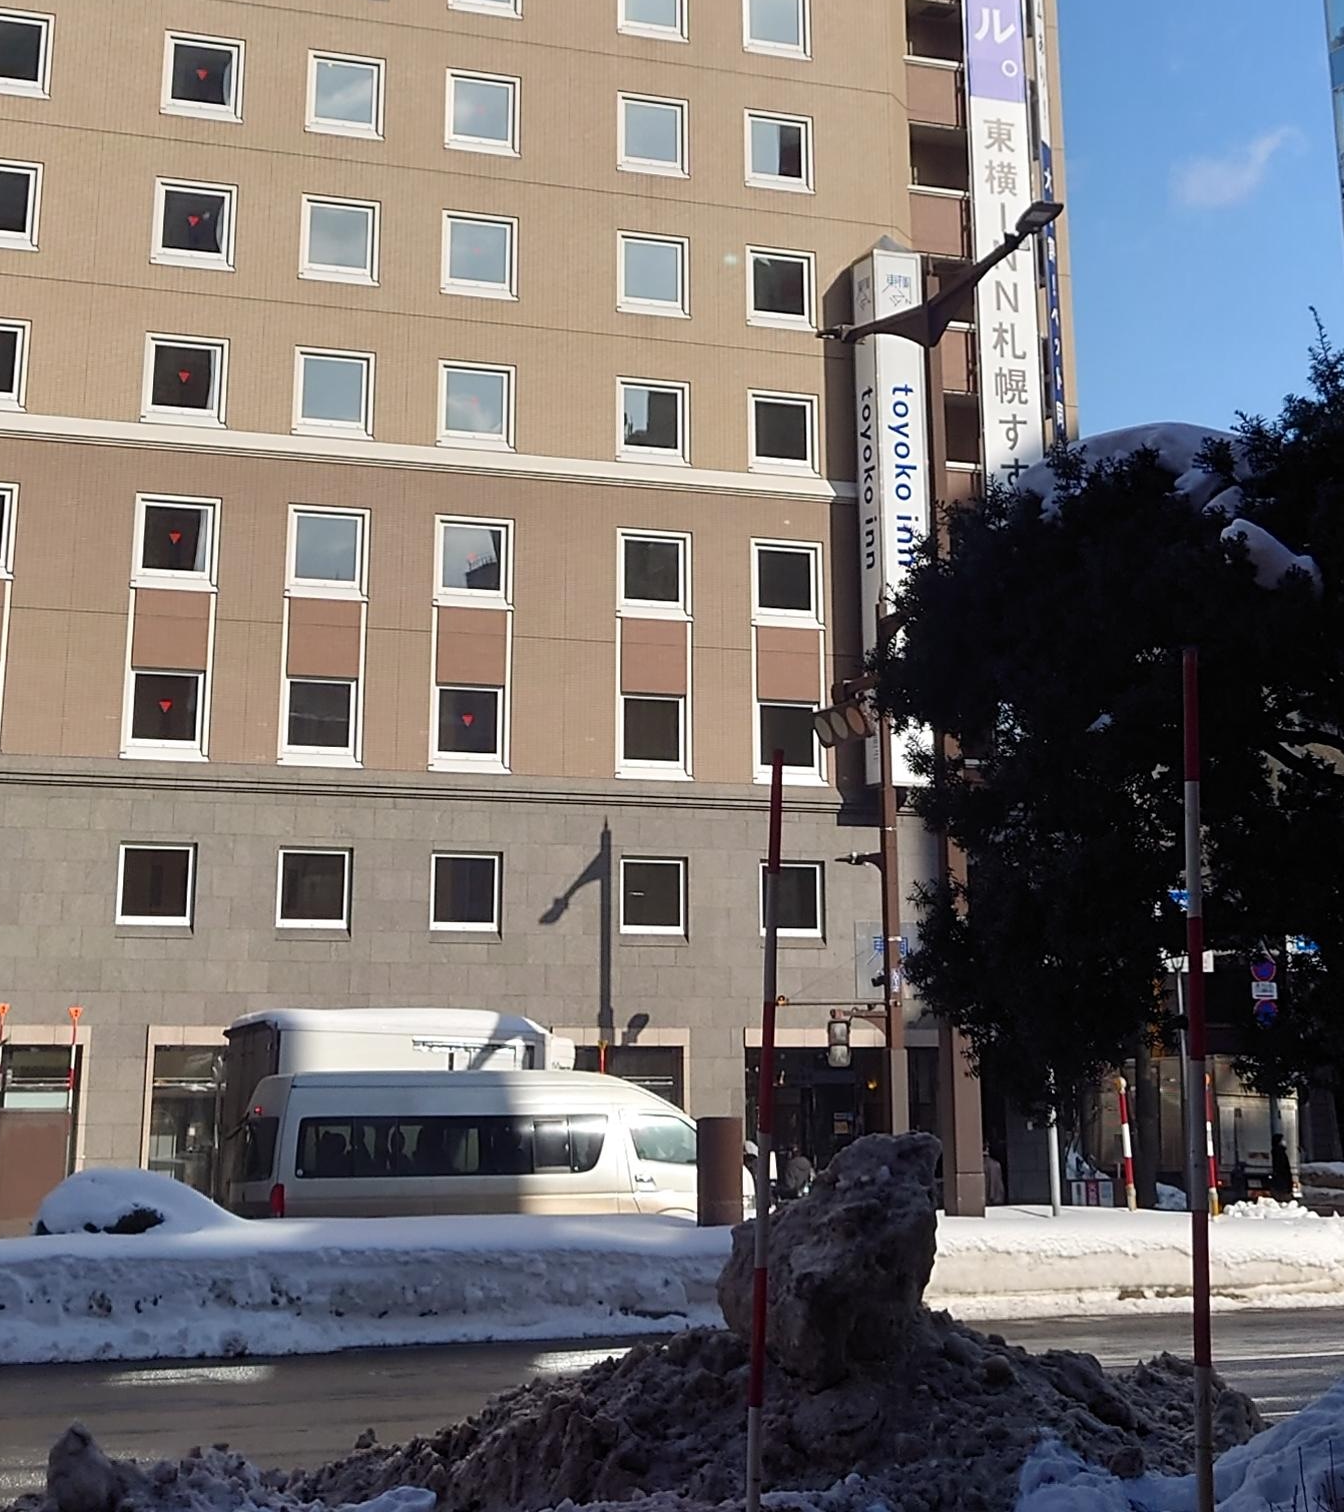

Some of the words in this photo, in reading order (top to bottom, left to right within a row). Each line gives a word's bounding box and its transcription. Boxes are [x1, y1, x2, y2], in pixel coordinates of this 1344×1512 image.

[860, 385, 876, 505] toyoko
[888, 383, 918, 502] toyoko
[864, 515, 877, 571] inn
